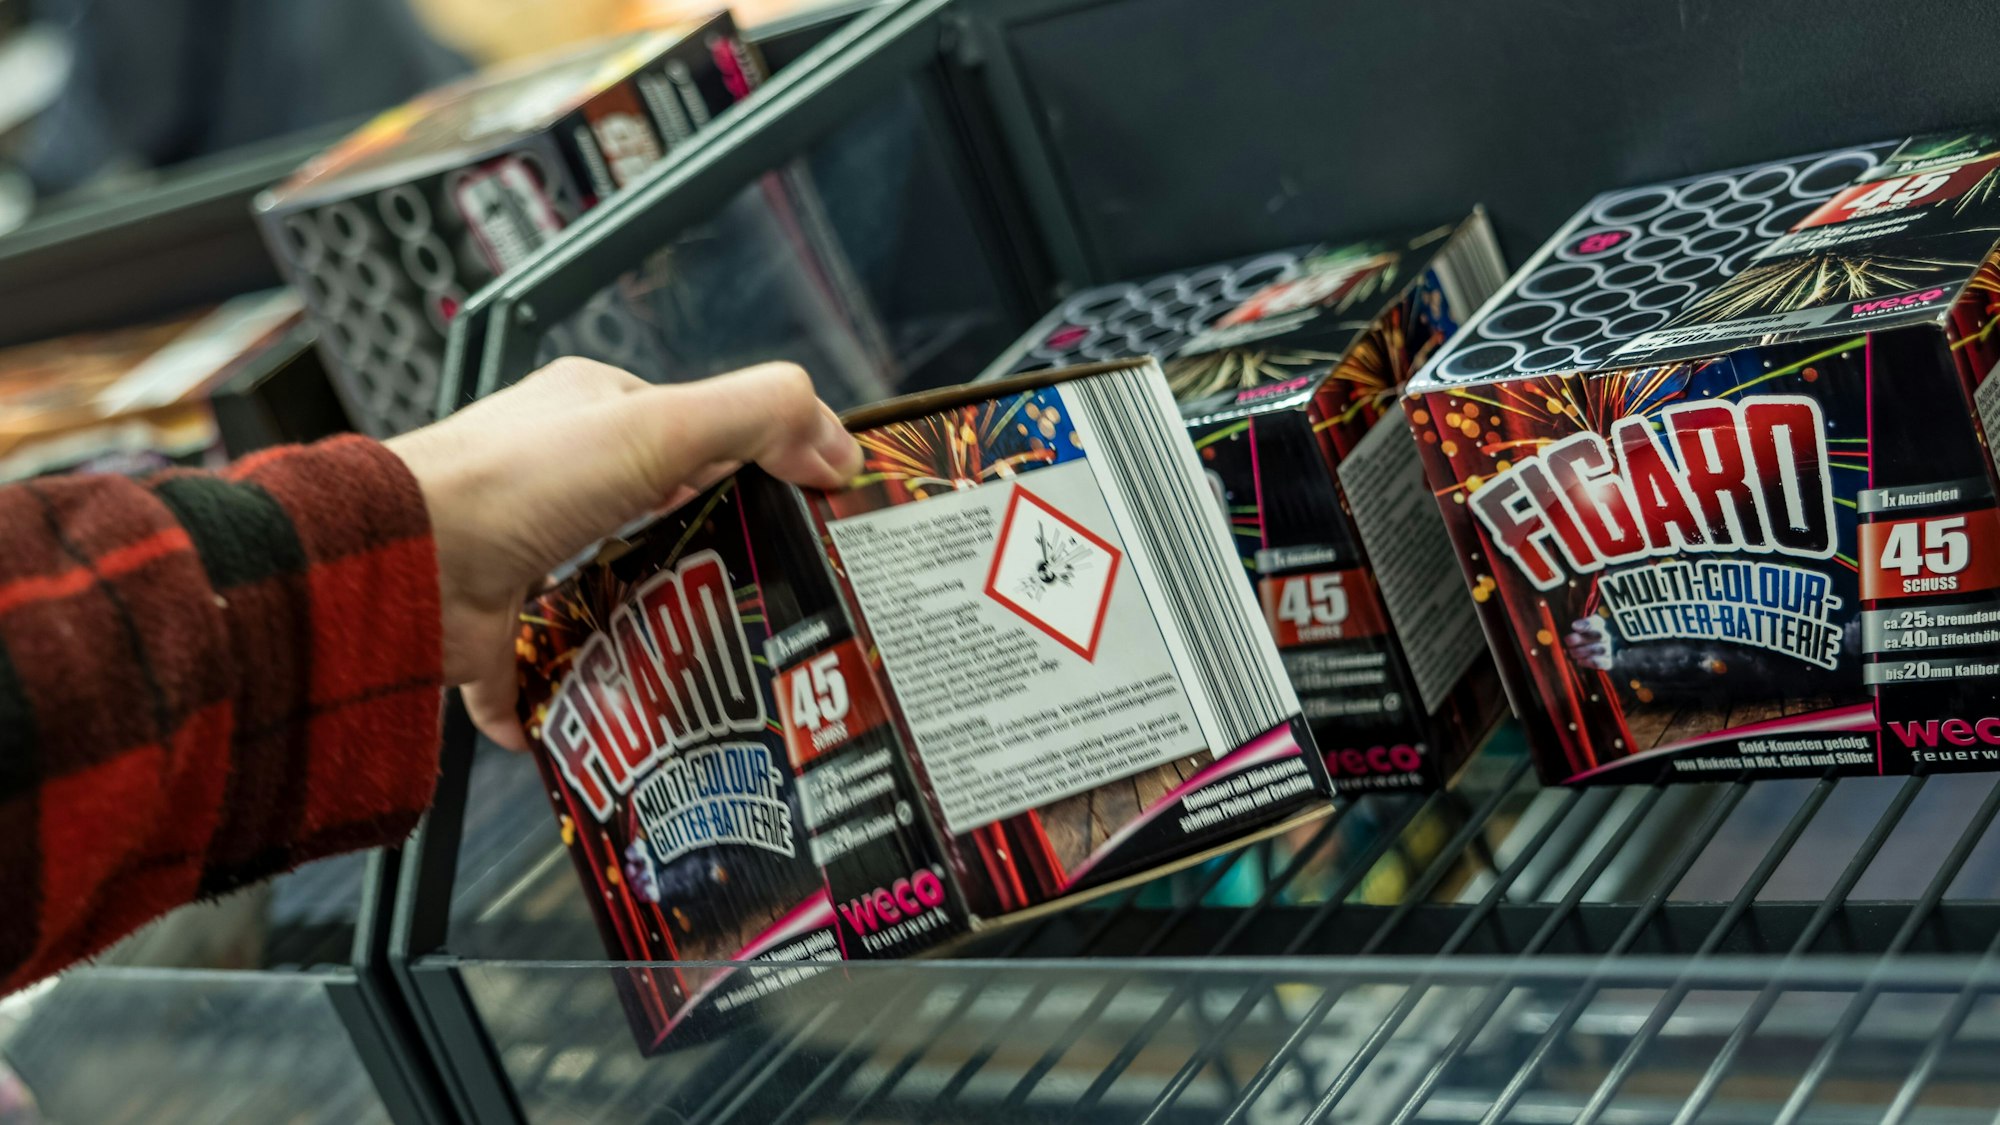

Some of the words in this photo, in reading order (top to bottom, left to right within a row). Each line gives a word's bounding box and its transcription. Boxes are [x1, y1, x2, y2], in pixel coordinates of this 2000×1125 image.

[1842, 167, 1962, 210] 45
[1851, 301, 1931, 319] feuerwerk
[1852, 288, 1944, 313] weco
[1468, 395, 1838, 591] FIGARO
[1878, 490, 1897, 508] 1x
[1898, 488, 1959, 507] Anzünden
[1880, 516, 1969, 576] 45
[1278, 571, 1350, 627] 45
[1598, 559, 1842, 622] MULTI-COLOUR-
[1902, 576, 1957, 593] SCHUSS
[1612, 598, 1843, 670] GLITTER-BATTERIE
[1941, 629, 2000, 646] Effekthöh
[541, 548, 767, 823] FIGARO
[791, 651, 850, 733] 45
[1954, 664, 1999, 677] Kaliber
[1673, 760, 1697, 772] von
[1696, 756, 1742, 770] Buketts
[1741, 755, 1757, 768] in
[1755, 754, 1780, 769] Rot,
[1779, 754, 1811, 767] Grün
[1810, 753, 1836, 766] und
[1835, 752, 1874, 764] Silber
[1737, 739, 1824, 754] Gold-Kometen
[1823, 736, 1871, 751] gefolgt
[632, 742, 784, 822] MULTI-COLOUR-
[1251, 785, 1274, 807] und
[648, 799, 796, 864] GLITTER-BATTERIE
[838, 868, 945, 937] weco
[861, 906, 950, 953] feuerwerk
